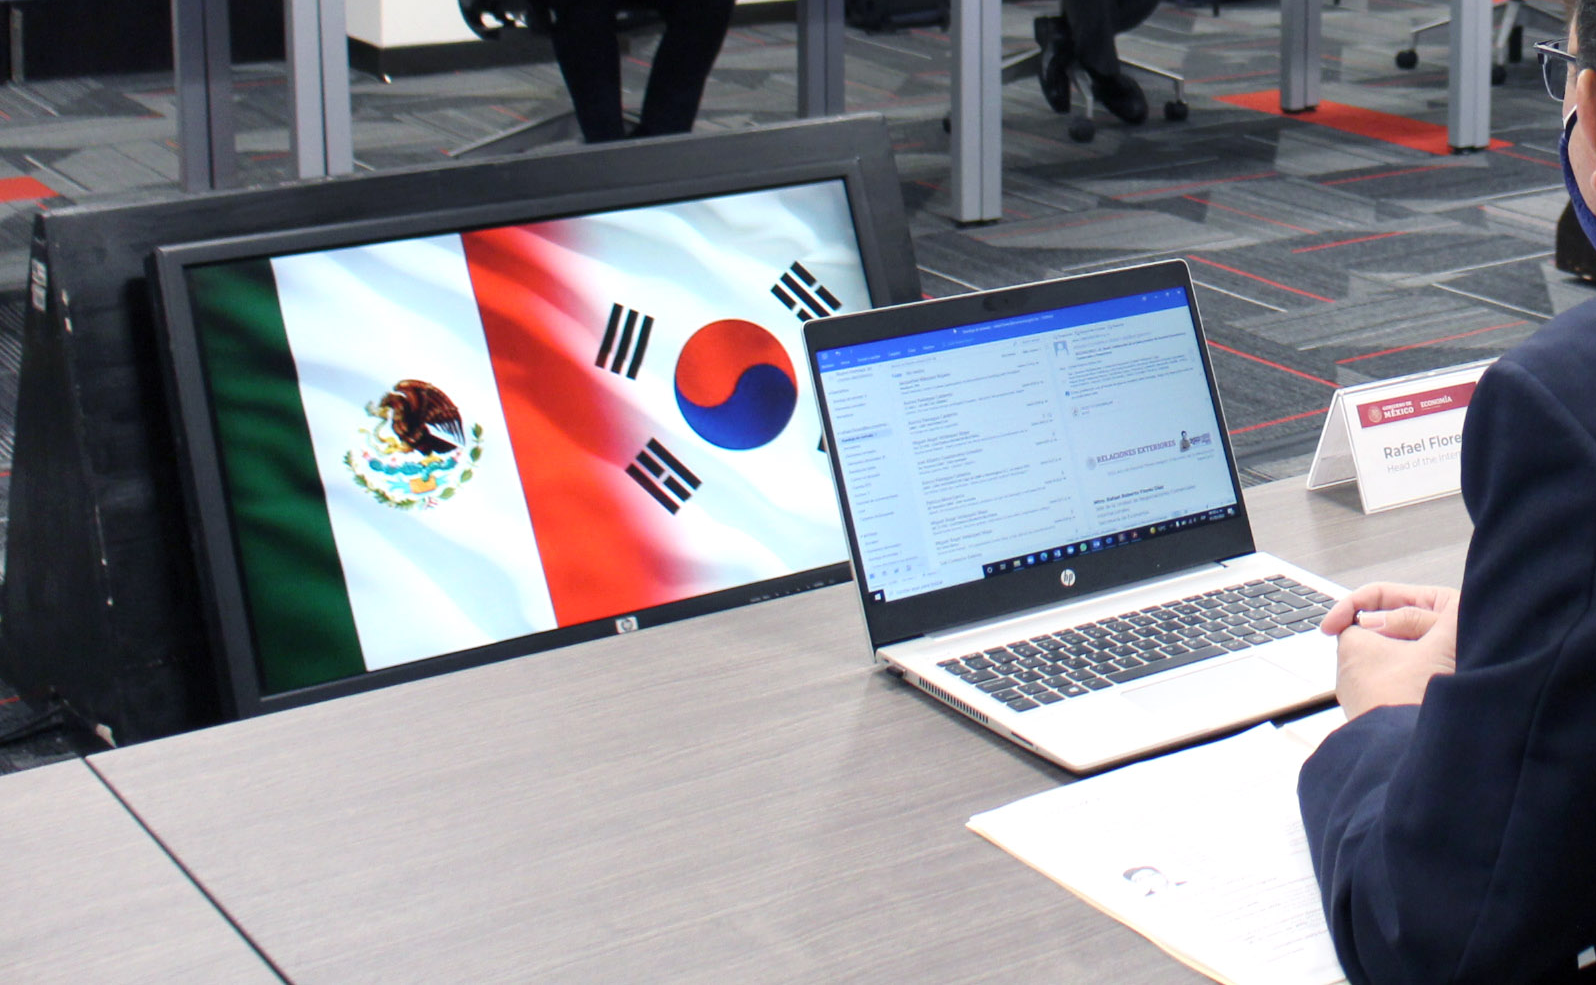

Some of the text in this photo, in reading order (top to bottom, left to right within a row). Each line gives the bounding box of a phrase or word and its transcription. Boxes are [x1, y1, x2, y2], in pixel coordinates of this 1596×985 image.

[1420, 395, 1452, 408] ECONOMÍA
[1384, 405, 1414, 418] MÉXICO
[1096, 448, 1136, 462] RELACIONES
[1137, 439, 1176, 454] EXTERIORES
[1384, 434, 1461, 459] Rafael Flore
[1387, 461, 1410, 473] Head
[1062, 569, 1075, 586] hp
